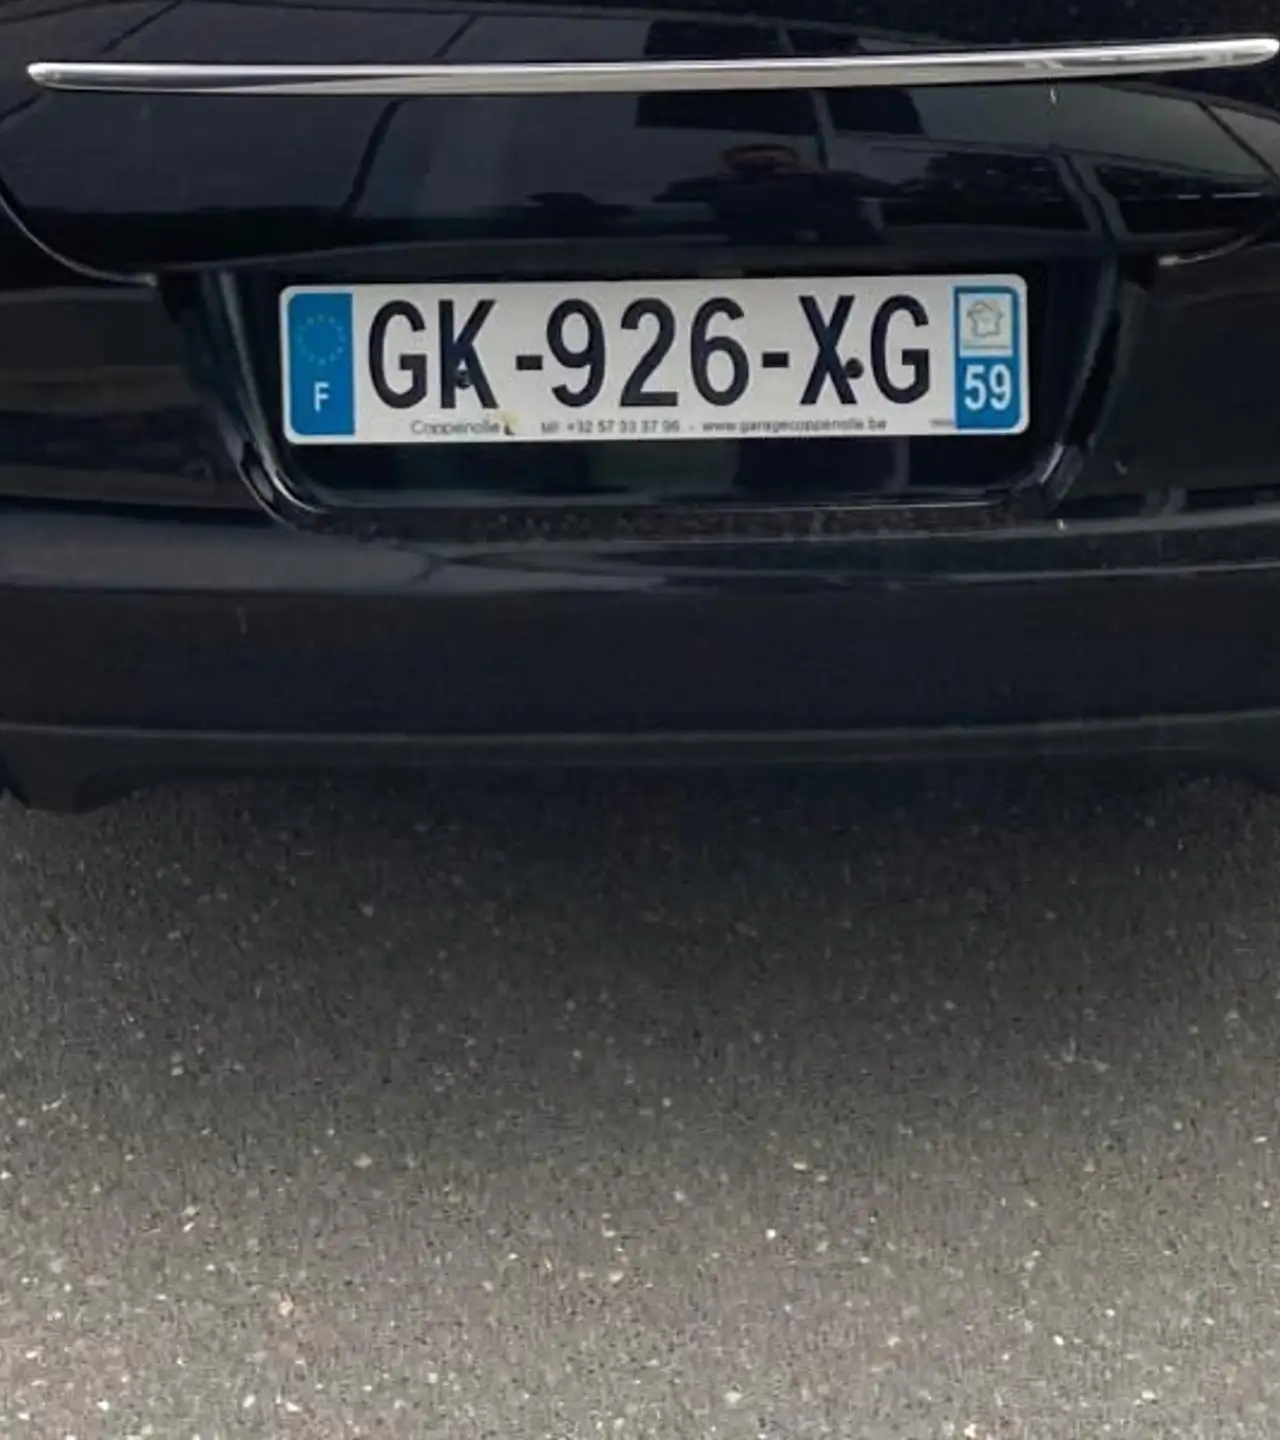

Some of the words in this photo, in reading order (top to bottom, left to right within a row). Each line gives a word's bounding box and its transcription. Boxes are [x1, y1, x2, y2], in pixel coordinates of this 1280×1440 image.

[367, 295, 931, 410] GK-926-XG
[314, 380, 330, 412] F
[963, 364, 1012, 411] 59
